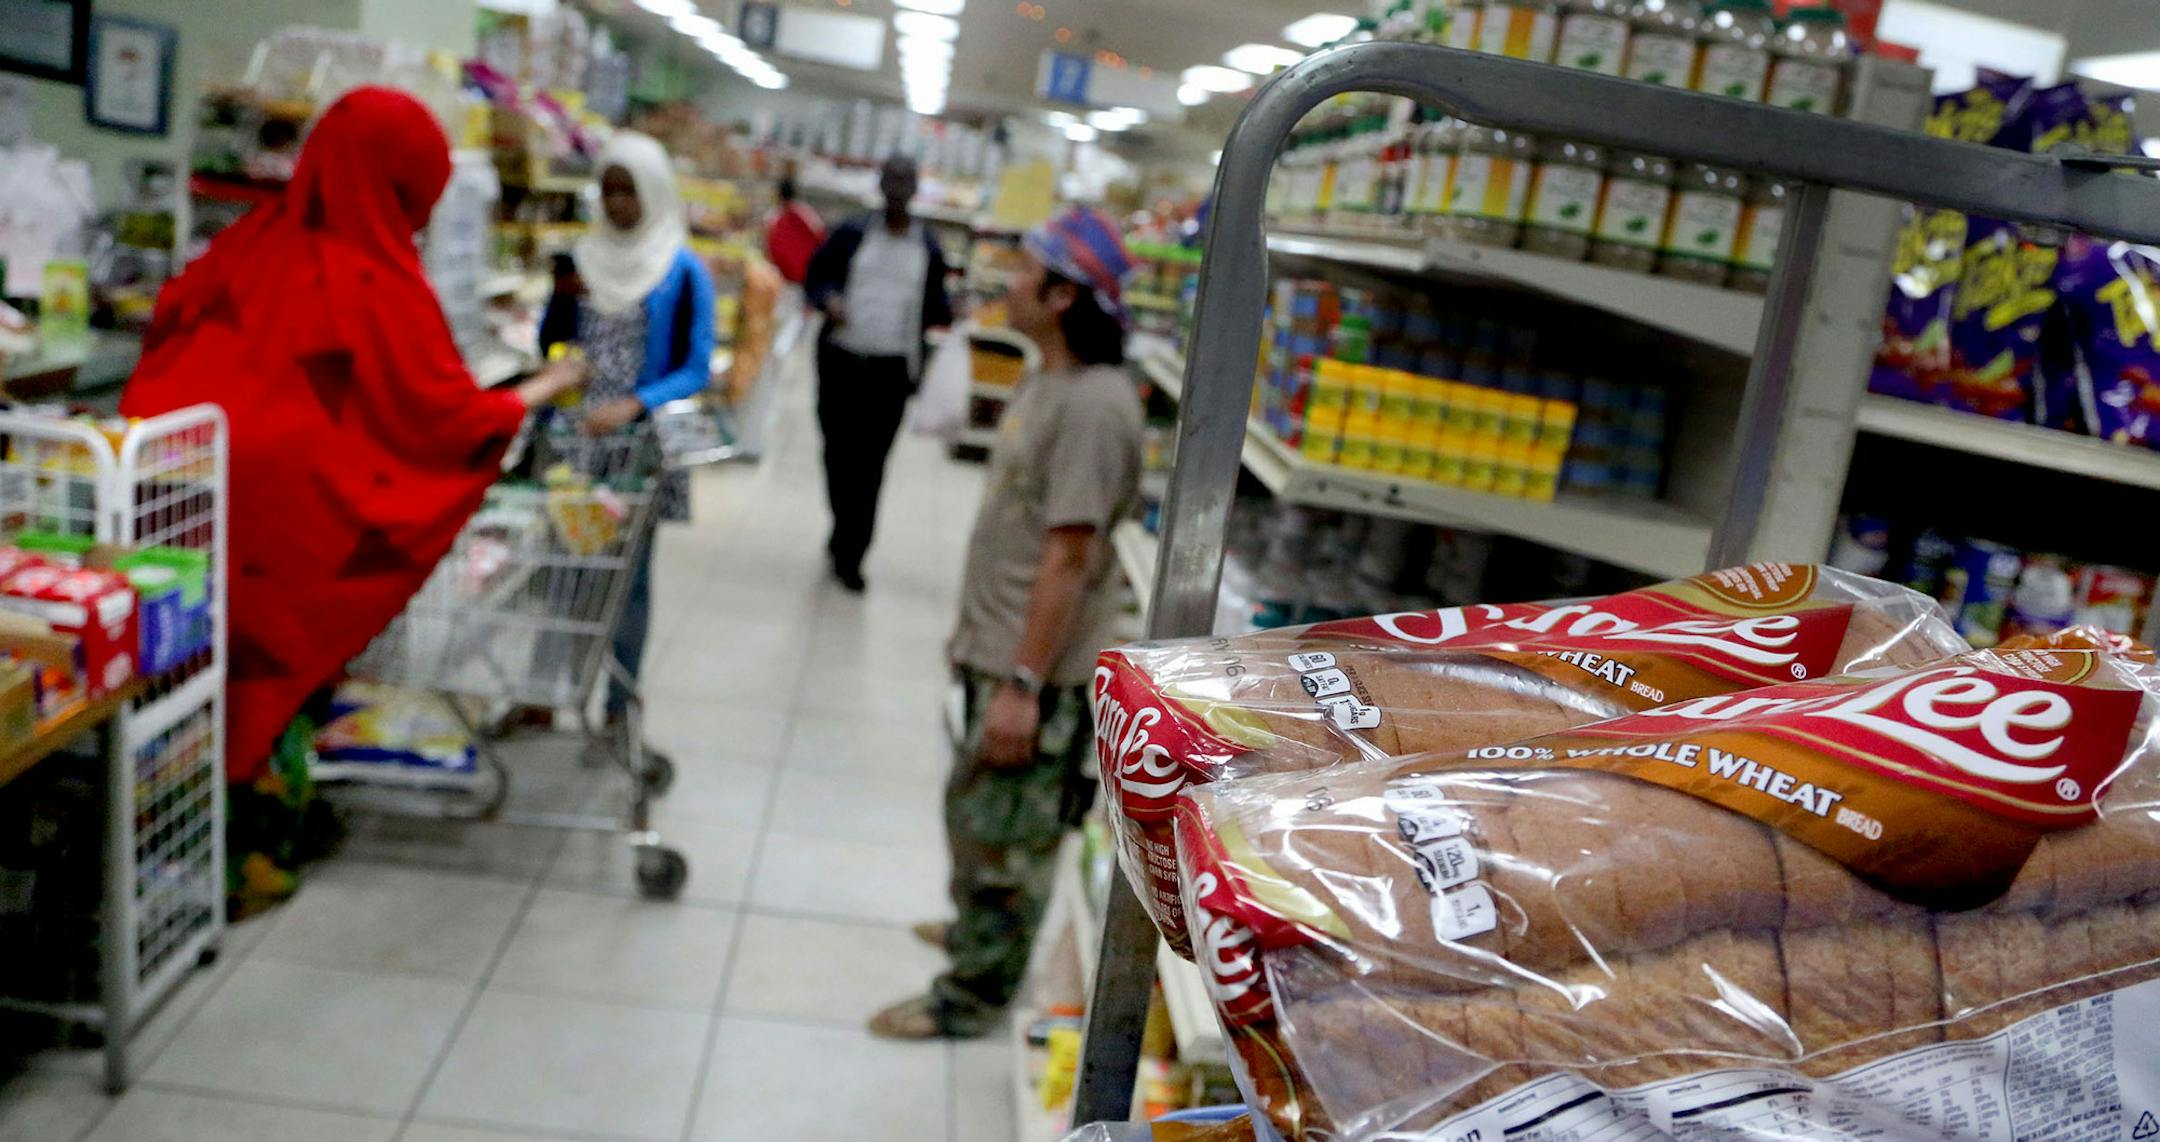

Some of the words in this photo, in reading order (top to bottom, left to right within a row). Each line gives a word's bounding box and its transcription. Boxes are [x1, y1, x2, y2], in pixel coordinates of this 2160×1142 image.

[1373, 599, 1642, 644] Sra
[1630, 681, 1665, 703] BREAD
[1803, 666, 2073, 784] Lee
[1467, 747, 1555, 760] 100%
[1566, 742, 1703, 768] WHOLE
[1708, 748, 1843, 818] WHEAT
[1834, 805, 1884, 841] BREAD
[1193, 872, 1261, 1000] Le
